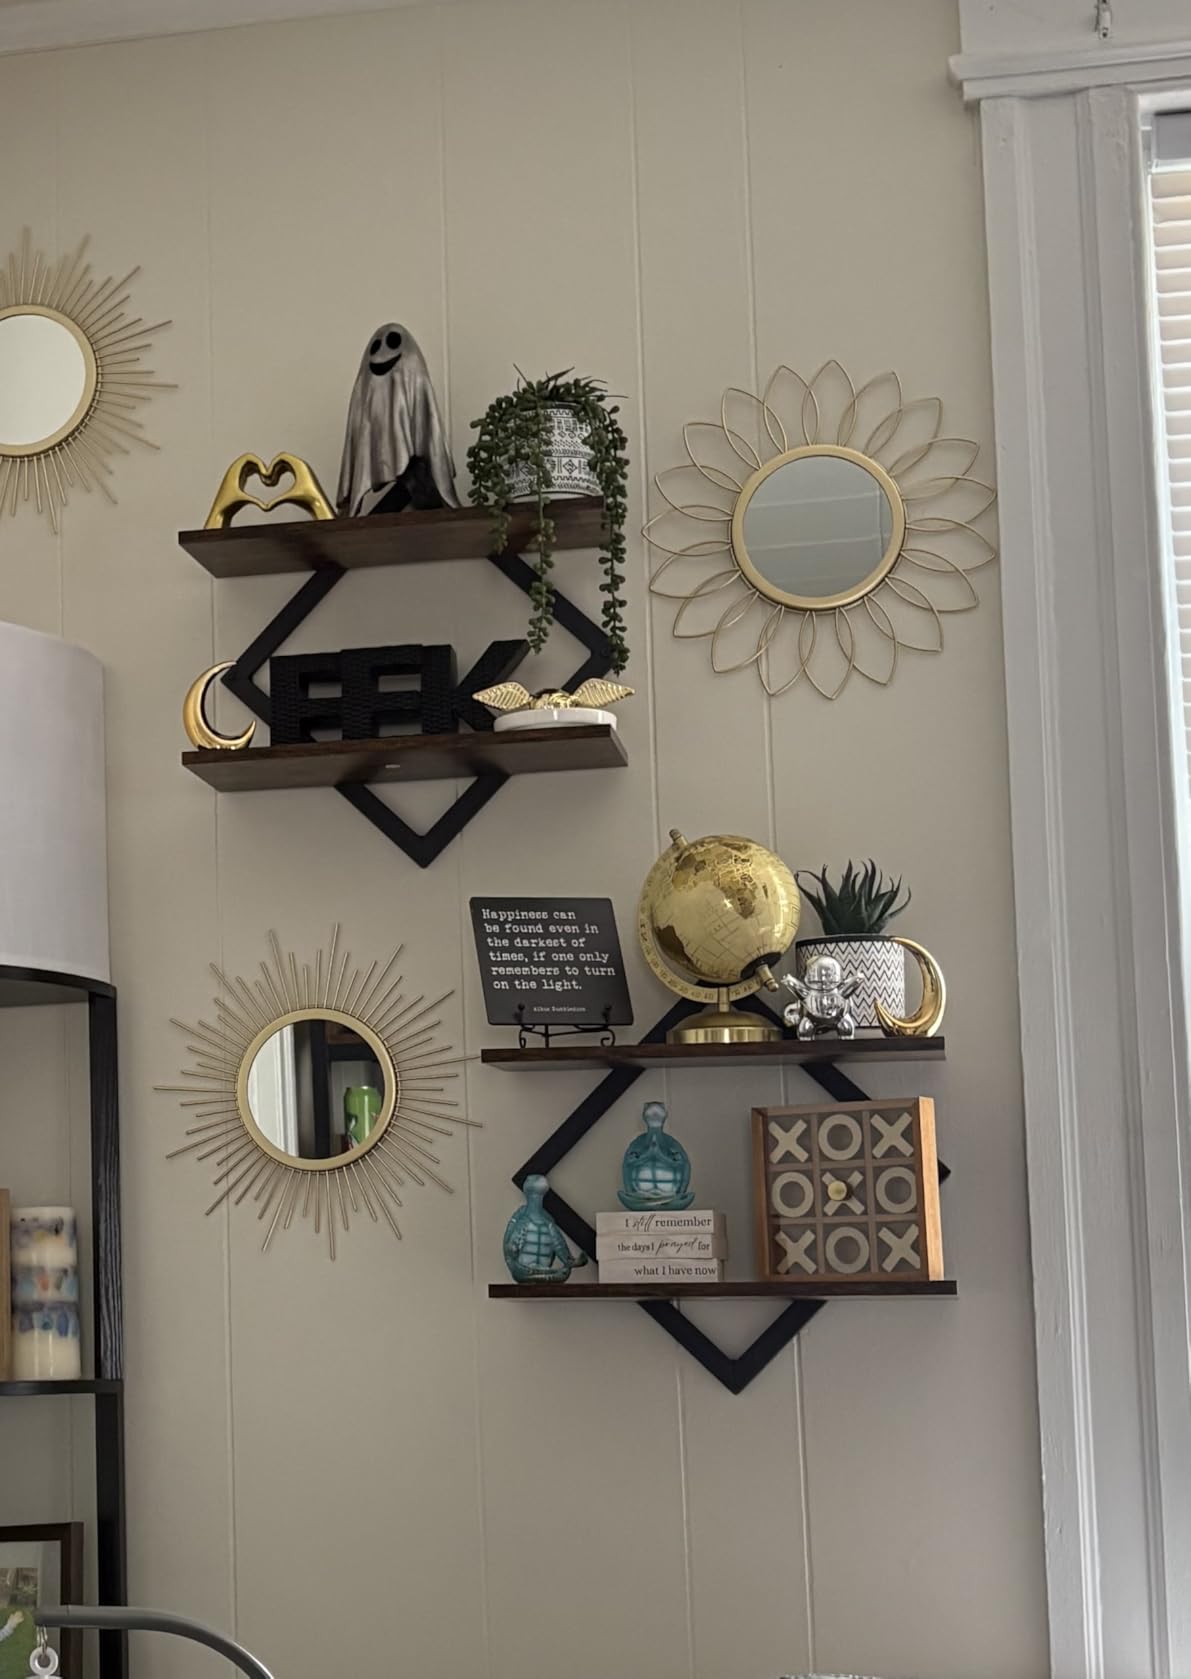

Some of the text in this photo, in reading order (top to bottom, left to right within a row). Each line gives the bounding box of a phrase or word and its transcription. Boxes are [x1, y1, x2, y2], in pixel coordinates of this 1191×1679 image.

[482, 909, 576, 921] Happiness can
[484, 924, 499, 933] be
[505, 923, 543, 933] found
[585, 924, 599, 934] in
[487, 937, 586, 947] the darkest of
[489, 952, 528, 962] times,
[533, 952, 546, 961] if
[579, 952, 609, 963] only
[491, 966, 615, 975] remembers to turn
[493, 979, 582, 991] on the light.
[625, 1214, 712, 1232] I still remember
[618, 1241, 631, 1251] the
[632, 1242, 649, 1253] days
[656, 1237, 698, 1255] prayed
[698, 1240, 709, 1250] for
[635, 1265, 716, 1276] what I have now
